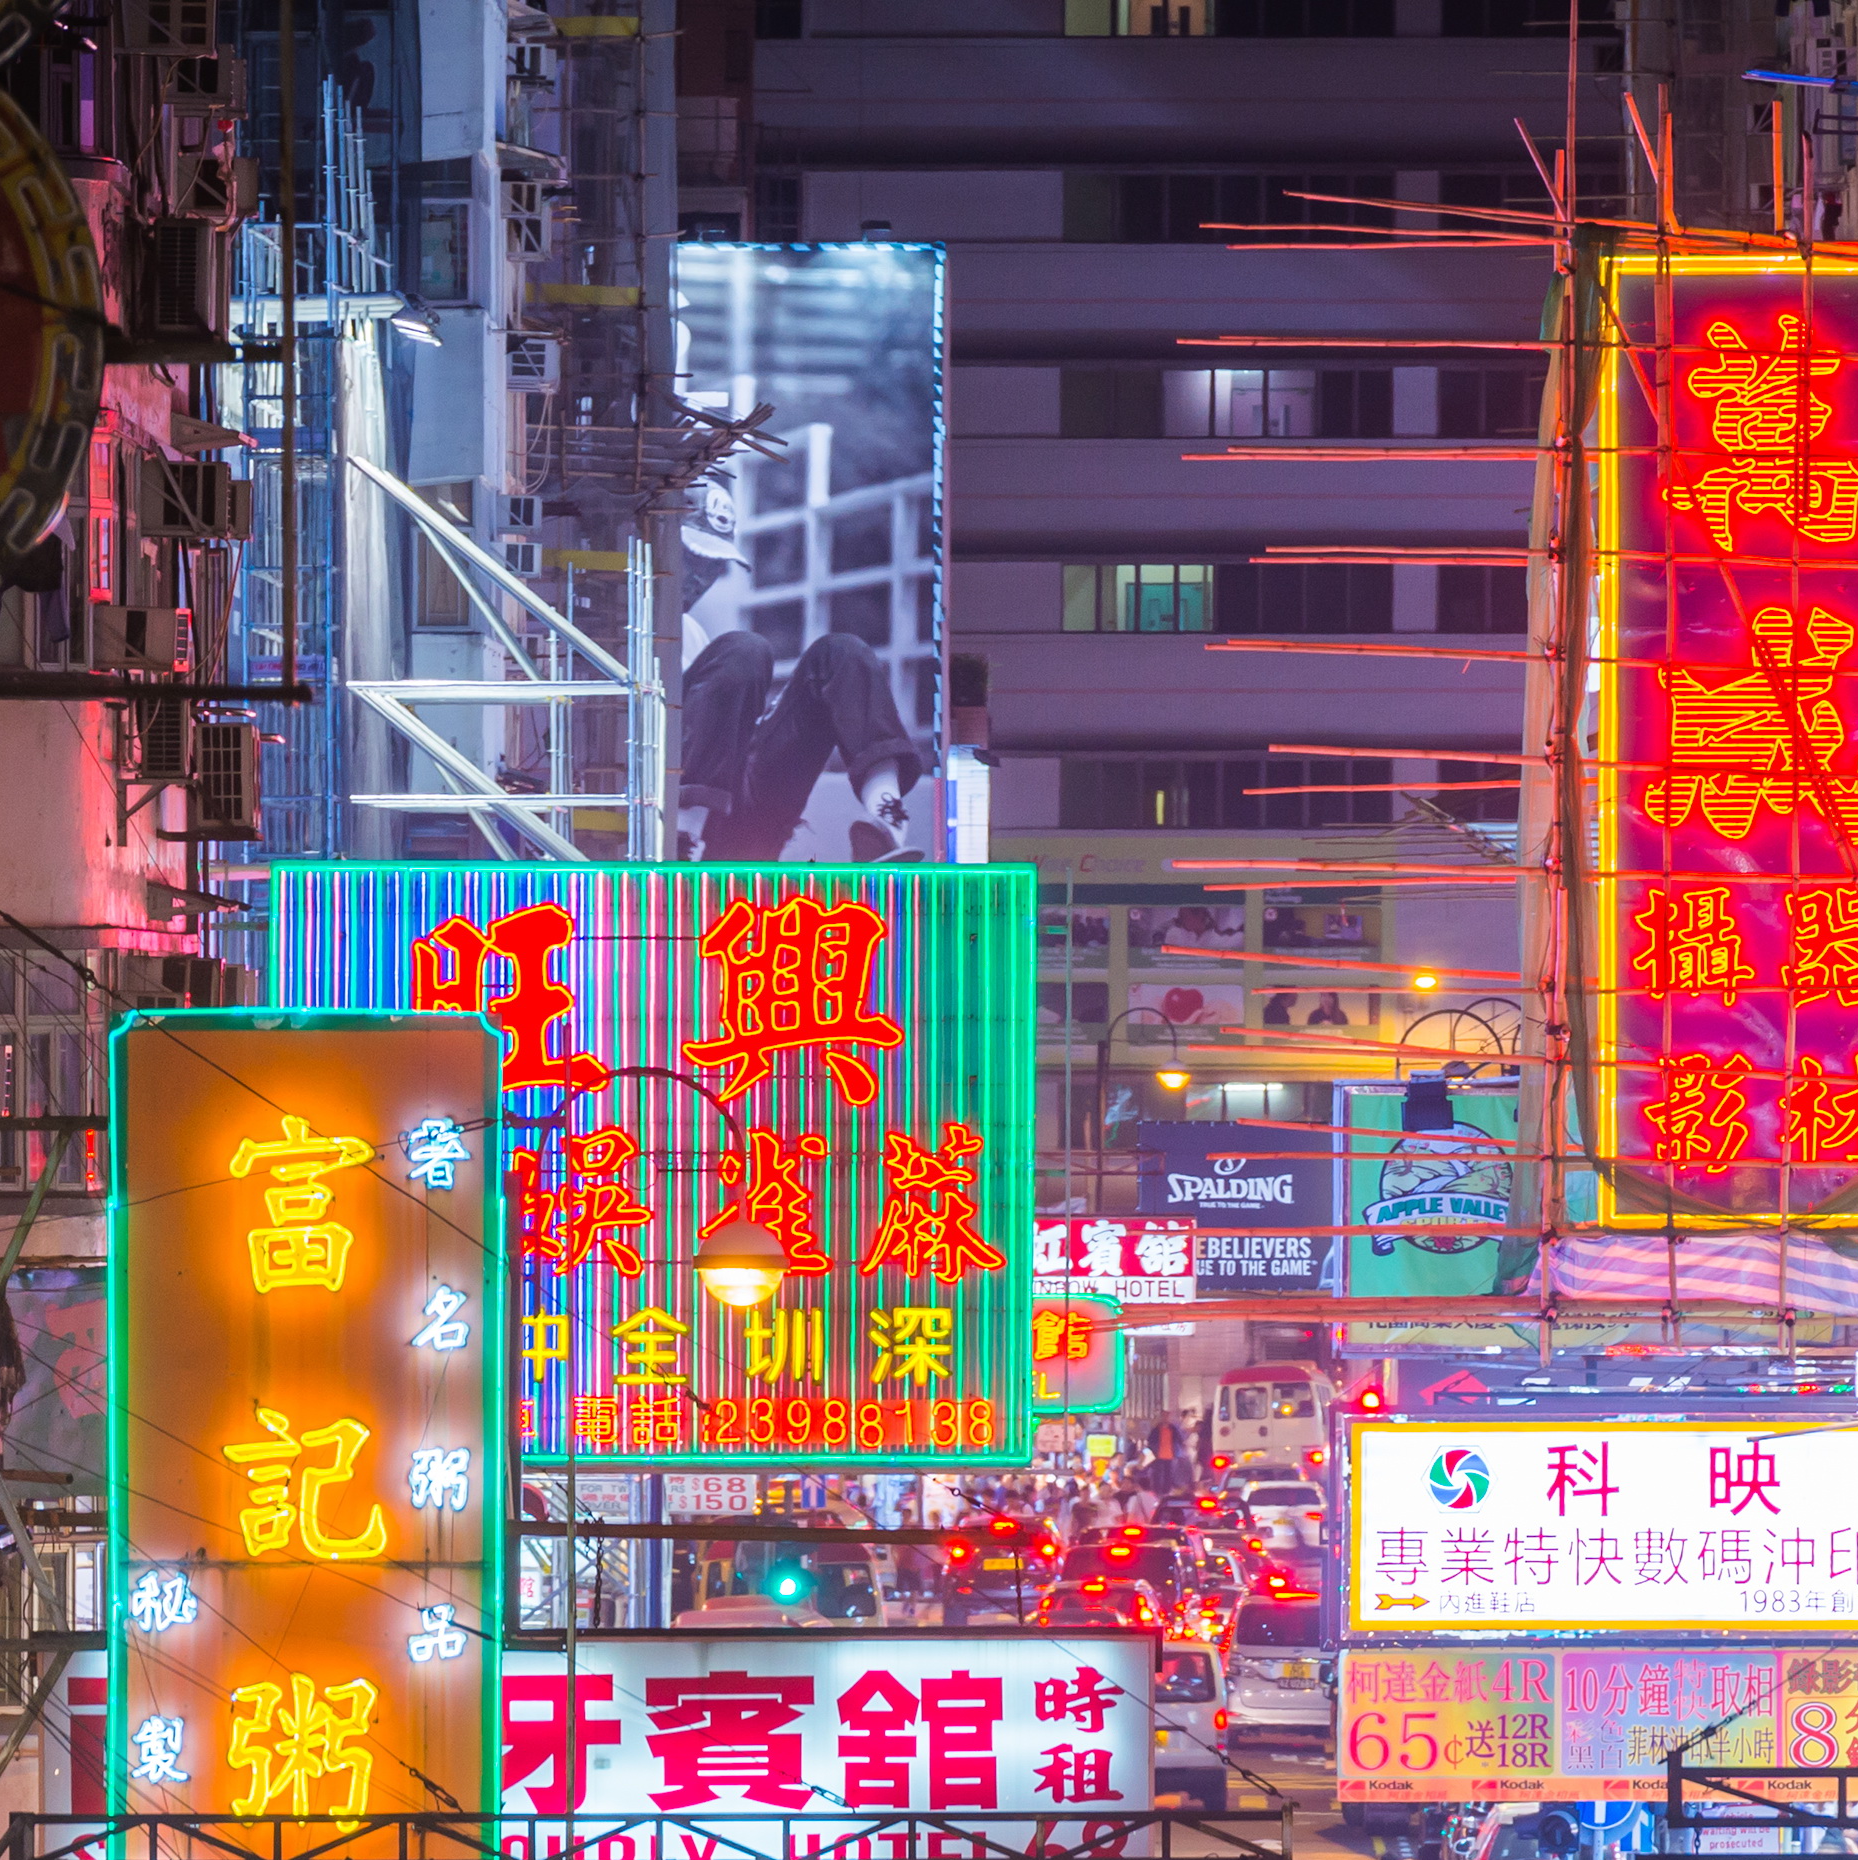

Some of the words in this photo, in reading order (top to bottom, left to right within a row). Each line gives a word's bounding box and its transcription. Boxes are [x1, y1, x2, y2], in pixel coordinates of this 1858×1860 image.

[1167, 1173, 1294, 1204] SPALDING
[1376, 1198, 1444, 1223] APPLE
[1219, 1260, 1235, 1275] TO
[1237, 1260, 1267, 1275] THE
[1115, 1279, 1185, 1298] HOTEL
[1034, 1666, 1125, 1804] 時租
[1465, 1719, 1496, 1760] 送
[1497, 1714, 1552, 1740] 12R
[1790, 1701, 1839, 1768] 8
[1497, 1742, 1552, 1769] 18R
[1369, 1779, 1413, 1791] Kodak
[1500, 1779, 1544, 1791] Kodak
[1632, 1779, 1668, 1791] Koda
[1767, 1779, 1812, 1791] Kodak
[1702, 1826, 1737, 1836] waiting
[1709, 1838, 1764, 1850] prosecuted
